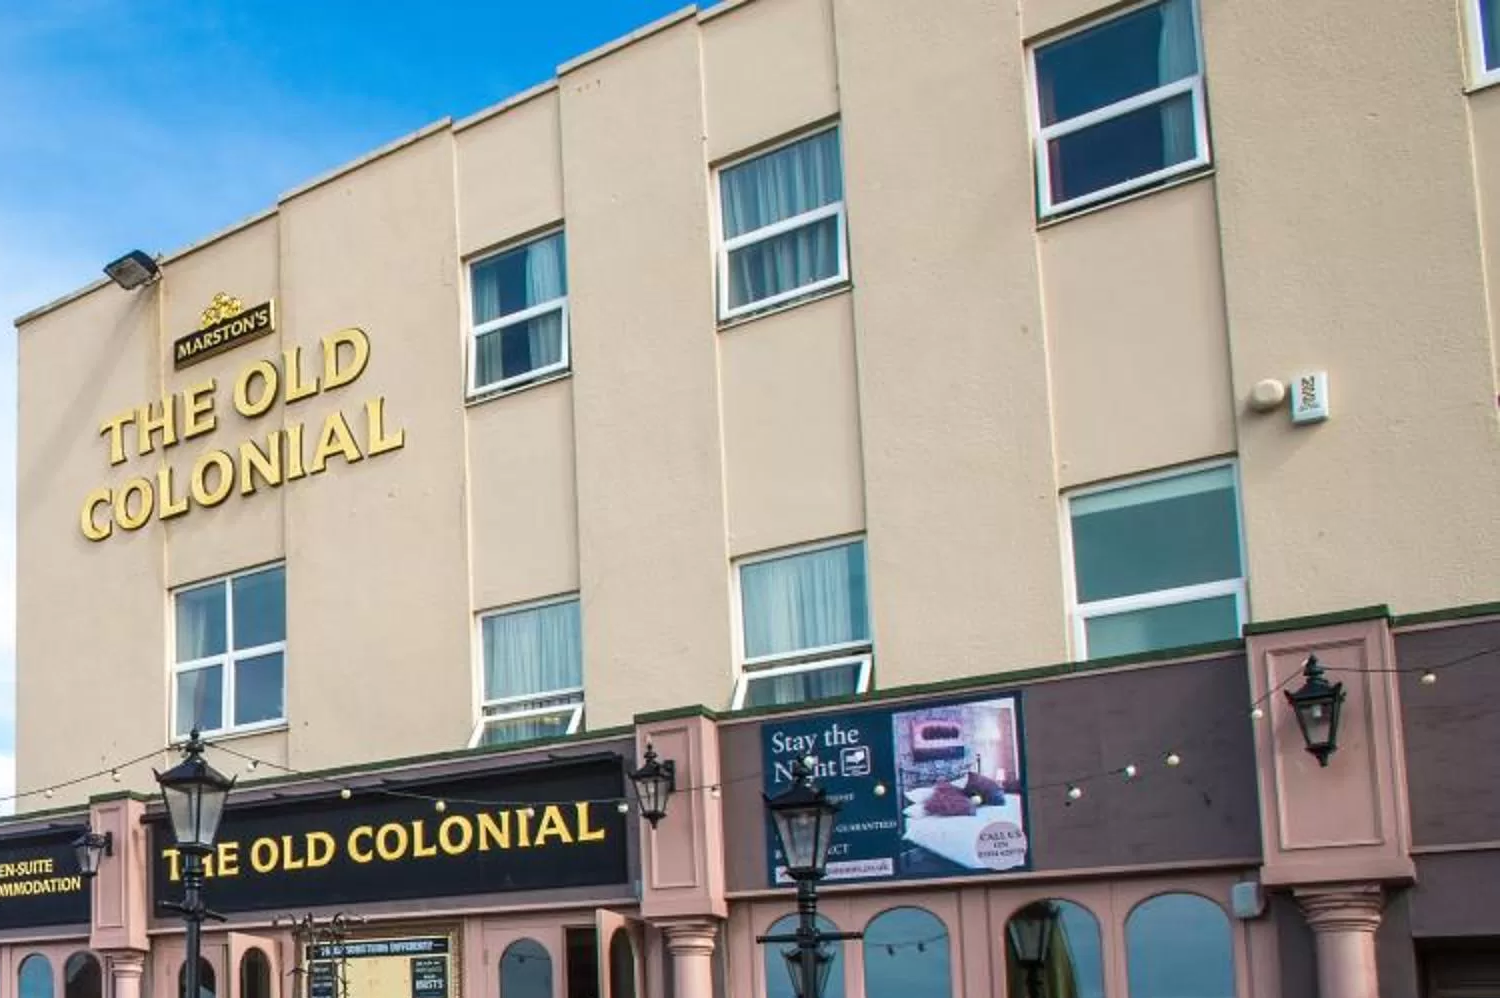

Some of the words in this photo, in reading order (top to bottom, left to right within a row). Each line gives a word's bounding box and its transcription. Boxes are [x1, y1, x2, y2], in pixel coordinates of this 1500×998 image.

[177, 309, 268, 360] MARSTON'S
[100, 376, 217, 467] THE
[233, 327, 371, 419] OLD
[80, 395, 405, 542] COLONIAL
[771, 731, 818, 754] Stay
[823, 724, 860, 747] the
[774, 756, 837, 783] Nht
[251, 831, 336, 874] OLD
[347, 801, 606, 864] COLONIAL
